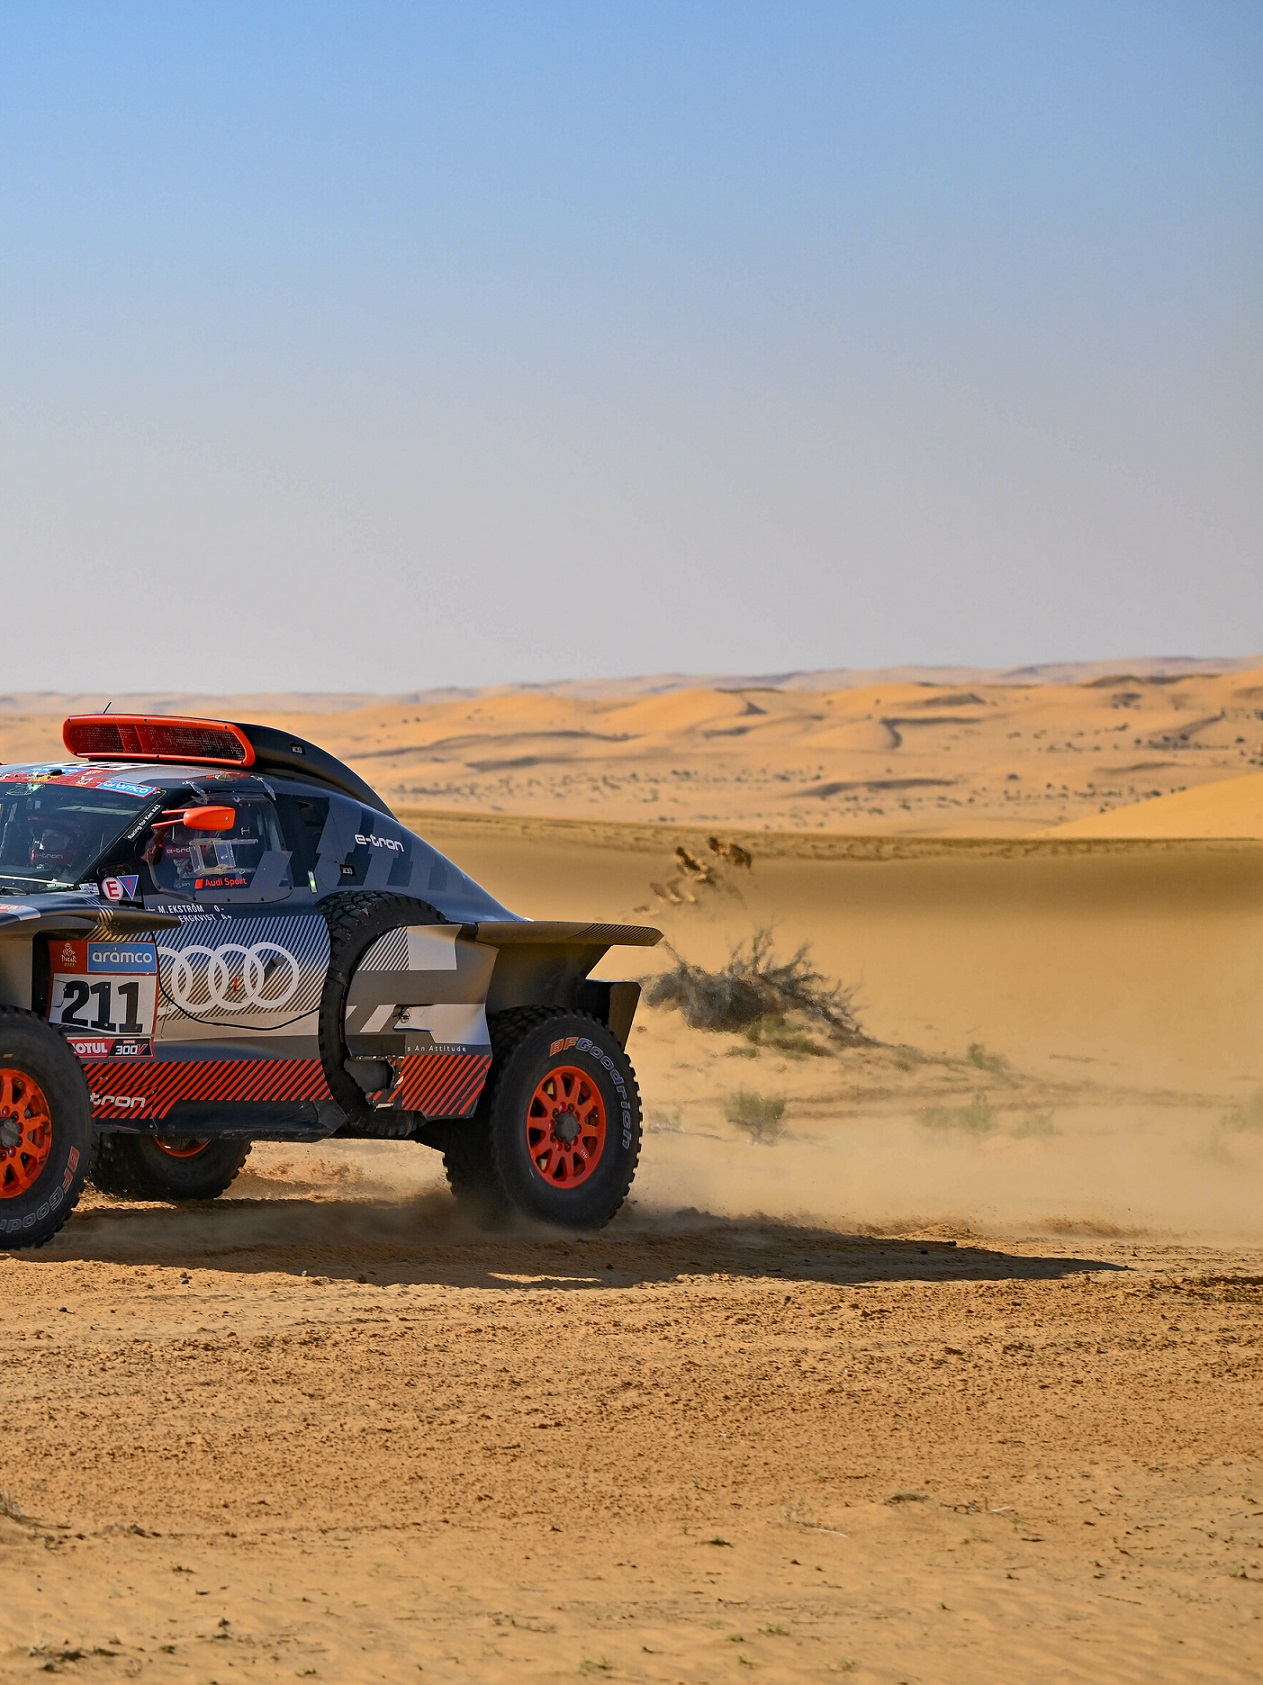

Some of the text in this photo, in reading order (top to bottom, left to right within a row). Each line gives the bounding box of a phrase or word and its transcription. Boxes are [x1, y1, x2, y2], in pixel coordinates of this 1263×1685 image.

[354, 834, 405, 852] e-tron
[105, 880, 120, 897] E
[205, 877, 247, 888] Audi Sport
[178, 913, 218, 923] ERGKVIST
[92, 948, 153, 964] aramco
[61, 980, 144, 1034] 211
[73, 1042, 108, 1054] OTUL
[115, 1044, 149, 1055] 300V
[414, 1044, 426, 1052] An
[428, 1044, 467, 1053] Attitude
[89, 1092, 147, 1108] tron
[549, 1036, 633, 1150] BFGoodrich
